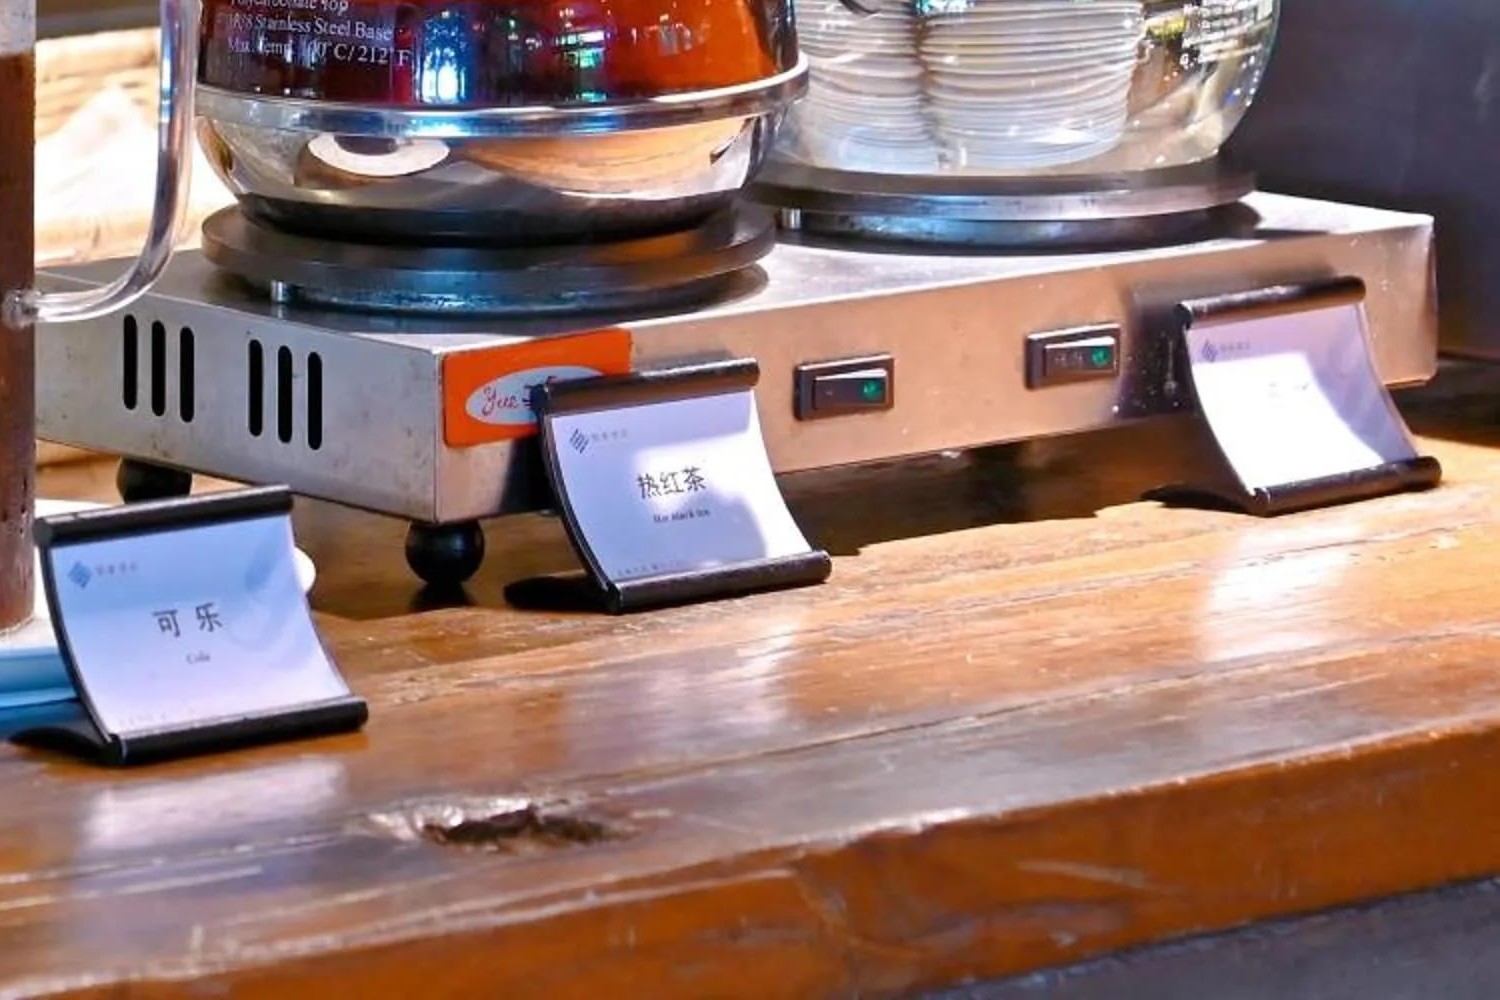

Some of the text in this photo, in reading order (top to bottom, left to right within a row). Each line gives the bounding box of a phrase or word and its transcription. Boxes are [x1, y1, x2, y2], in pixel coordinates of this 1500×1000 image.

[255, 14, 311, 34] Stainless
[314, 17, 351, 37] Steel
[354, 21, 394, 41] Base
[636, 464, 707, 499] 热红茶
[152, 601, 223, 638] 可乐
